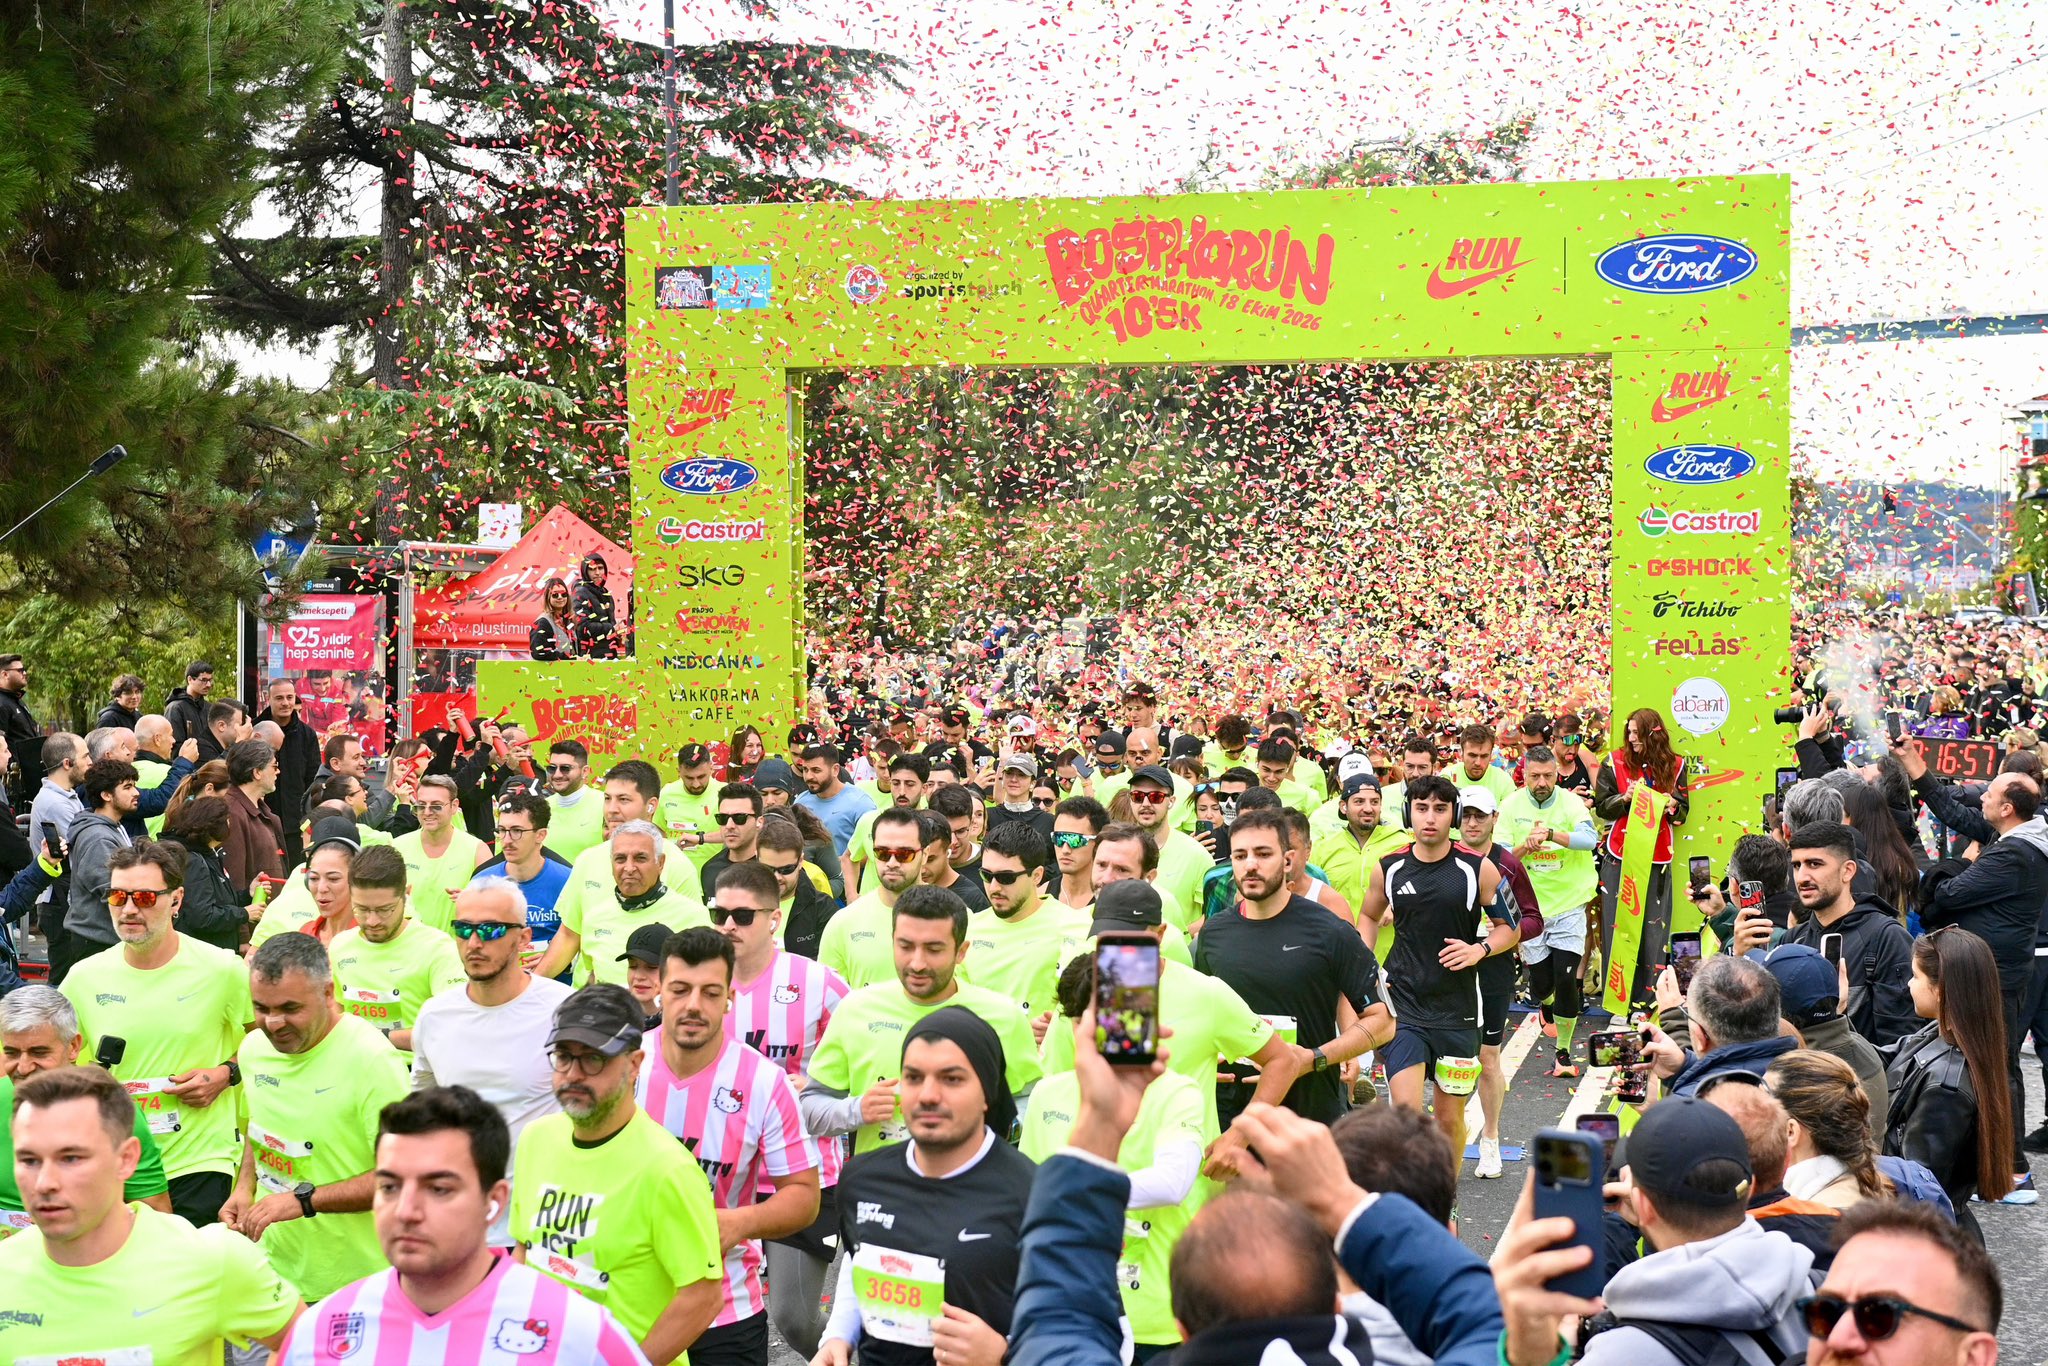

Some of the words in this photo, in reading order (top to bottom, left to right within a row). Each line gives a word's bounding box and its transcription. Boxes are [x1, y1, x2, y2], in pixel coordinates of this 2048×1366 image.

[1044, 215, 1335, 307] BOSPHORUN
[1446, 237, 1522, 271] RUN
[1627, 244, 1722, 282] Ford
[952, 271, 963, 280] by
[1079, 274, 1148, 326] QUARTER
[1149, 276, 1214, 302] MARATHON
[1219, 292, 1239, 310] 18
[1281, 309, 1323, 331] 2026
[1669, 372, 1732, 399] RUN
[678, 388, 736, 415] RUN
[1666, 450, 1733, 477] Ford
[679, 462, 738, 487] Ford
[685, 519, 765, 539] Castrol
[1671, 512, 1759, 532] Castrol
[271, 539, 286, 562] P
[679, 565, 745, 587] SKG
[1648, 558, 1752, 577] G-SHOCK
[296, 605, 347, 616] emeksepeti
[1677, 601, 1743, 618] Tchibo
[433, 622, 533, 636] www.plustimin
[675, 608, 750, 635] FENOMEN
[290, 627, 320, 648] 25
[286, 647, 310, 662] hep
[312, 647, 355, 659] seninle
[669, 688, 760, 702] VAKKORAMA
[1673, 696, 1725, 713] abant
[695, 707, 734, 720] CAFE
[1633, 787, 1652, 820] RUN
[1532, 852, 1558, 861] 3406
[1620, 874, 1635, 907] RUN
[526, 907, 558, 922] -Wish
[1608, 959, 1625, 993] RUN
[352, 1003, 387, 1019] 2169
[1446, 1069, 1476, 1080] 1661
[138, 1096, 161, 1111] 74
[258, 1149, 293, 1175] 2061
[536, 1188, 594, 1237] RUN
[866, 1277, 922, 1308] 3658
